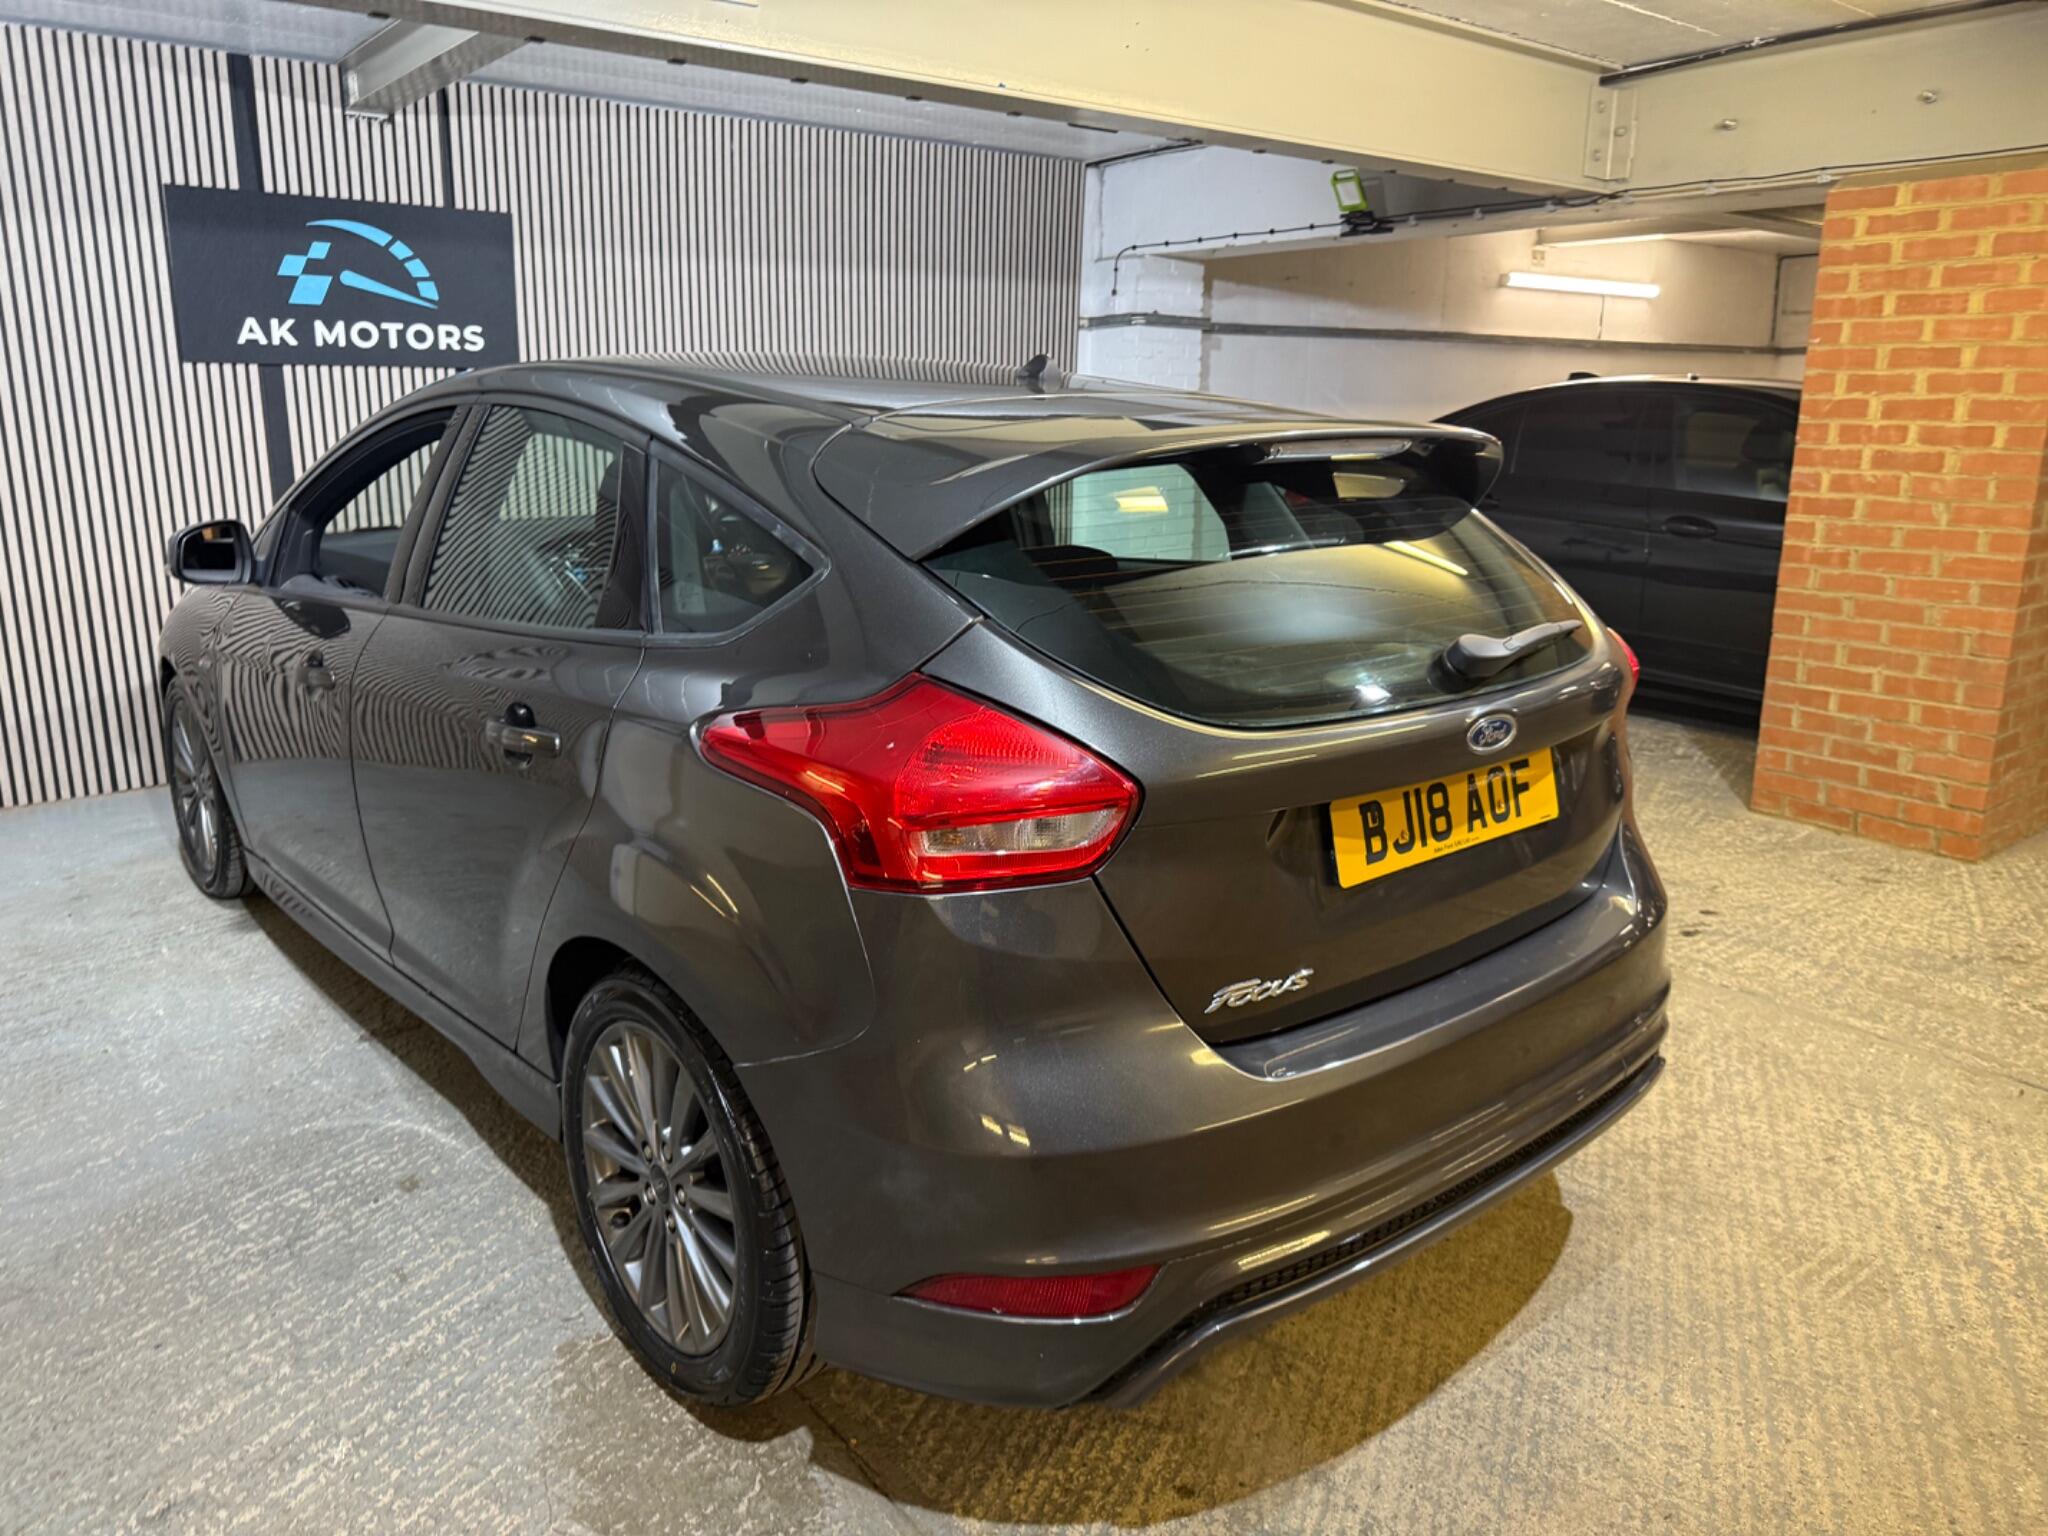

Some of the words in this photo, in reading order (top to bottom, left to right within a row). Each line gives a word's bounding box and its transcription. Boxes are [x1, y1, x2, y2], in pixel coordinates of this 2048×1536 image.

[237, 316, 299, 346] AK
[313, 320, 486, 352] MOTORS
[1478, 720, 1509, 746] Ford
[1358, 781, 1454, 866] BJ18
[1465, 758, 1531, 834] AOF
[1204, 967, 1315, 1014] Focus
